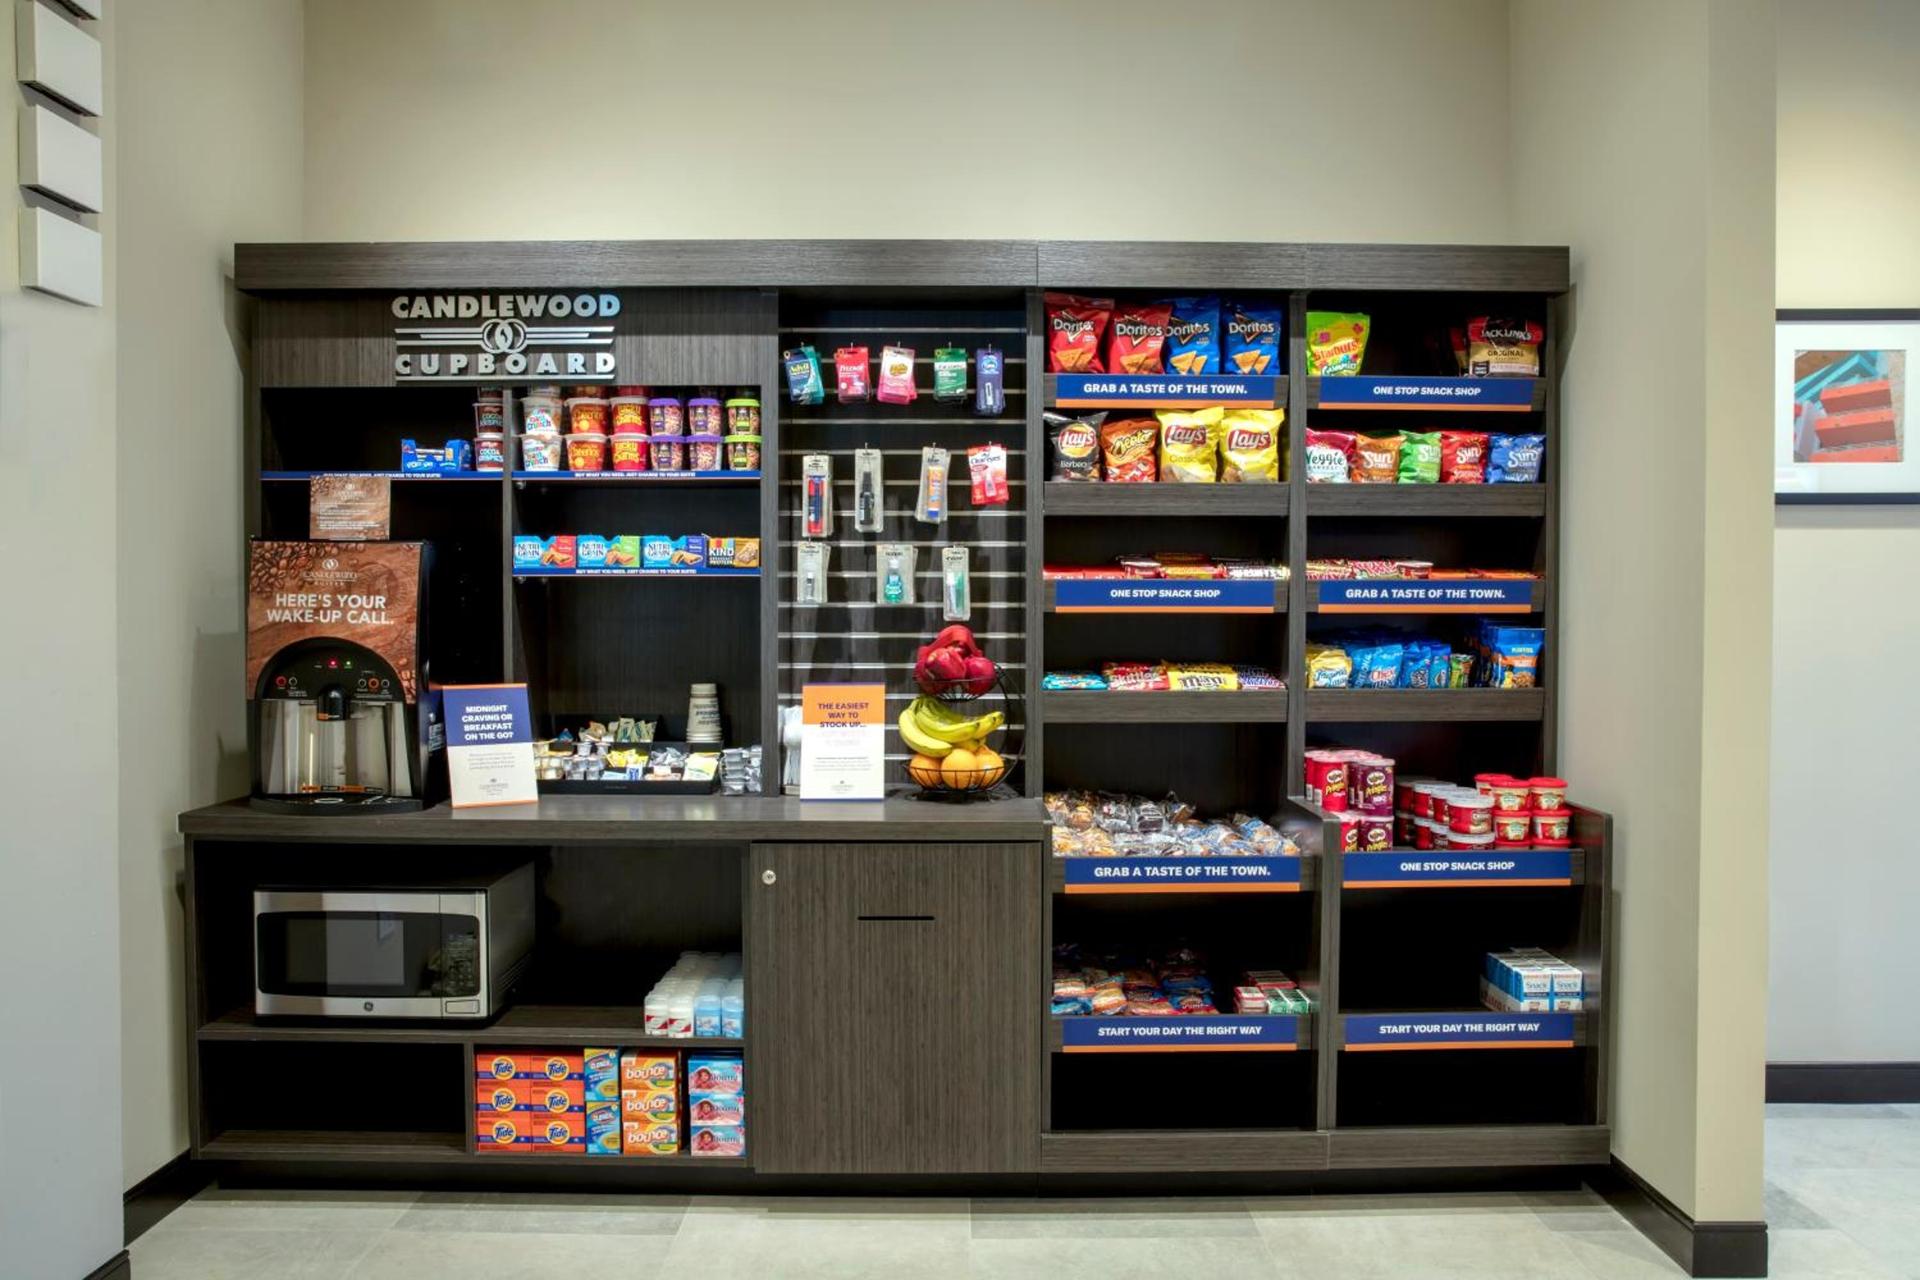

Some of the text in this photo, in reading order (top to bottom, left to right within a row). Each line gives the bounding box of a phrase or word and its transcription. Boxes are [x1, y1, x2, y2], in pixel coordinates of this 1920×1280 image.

[392, 294, 621, 318] CANDLEWOOD
[1116, 324, 1162, 335] Doritos
[1229, 322, 1274, 334] Doritos
[395, 353, 616, 374] CUPBOARD
[1083, 383, 1248, 394] GRAB A TASTE OF THE TOWN.
[1373, 386, 1481, 396] ONE STOP SNACK SHOP
[1061, 431, 1095, 448] Lay's
[1166, 425, 1207, 446] Lay's
[1229, 430, 1270, 449] Lay's
[1305, 451, 1344, 465] Veggie
[1364, 451, 1393, 469] Sun
[1456, 447, 1480, 464] Sun
[1508, 451, 1537, 468] Sun
[709, 548, 734, 557] KIND
[1110, 589, 1221, 598] ONE STOP SNACK SHOP
[1345, 589, 1505, 598] GRAB A TASTE OF THE TOWN.
[276, 594, 386, 609] HERE'S YOUR
[267, 609, 394, 625] WAKE-UP CALL.
[466, 705, 507, 713] MIDNIGHT
[835, 702, 869, 710] EASIEST
[461, 714, 500, 722] CRAVING
[464, 722, 512, 732] BREAKFAST
[465, 733, 478, 741] ON
[479, 732, 495, 740] THE
[1094, 866, 1271, 877] GRAB A TASTE OF THE TOWN.
[1400, 862, 1515, 871] ONE STOP SNACK SHOP
[1098, 1026, 1262, 1036] START YOUR DAY THE RIGHT WAY
[1379, 1023, 1540, 1034] START YOUR DAY THE RIGHT WAY
[494, 1062, 512, 1075] Tide
[547, 1063, 567, 1076] Tide
[626, 1066, 667, 1080] bounce
[494, 1094, 513, 1108] Tide
[547, 1095, 567, 1108] Tide
[626, 1098, 667, 1112] bounce
[494, 1126, 514, 1139] Tide
[548, 1126, 568, 1140] Tide
[627, 1129, 669, 1143] bounce
